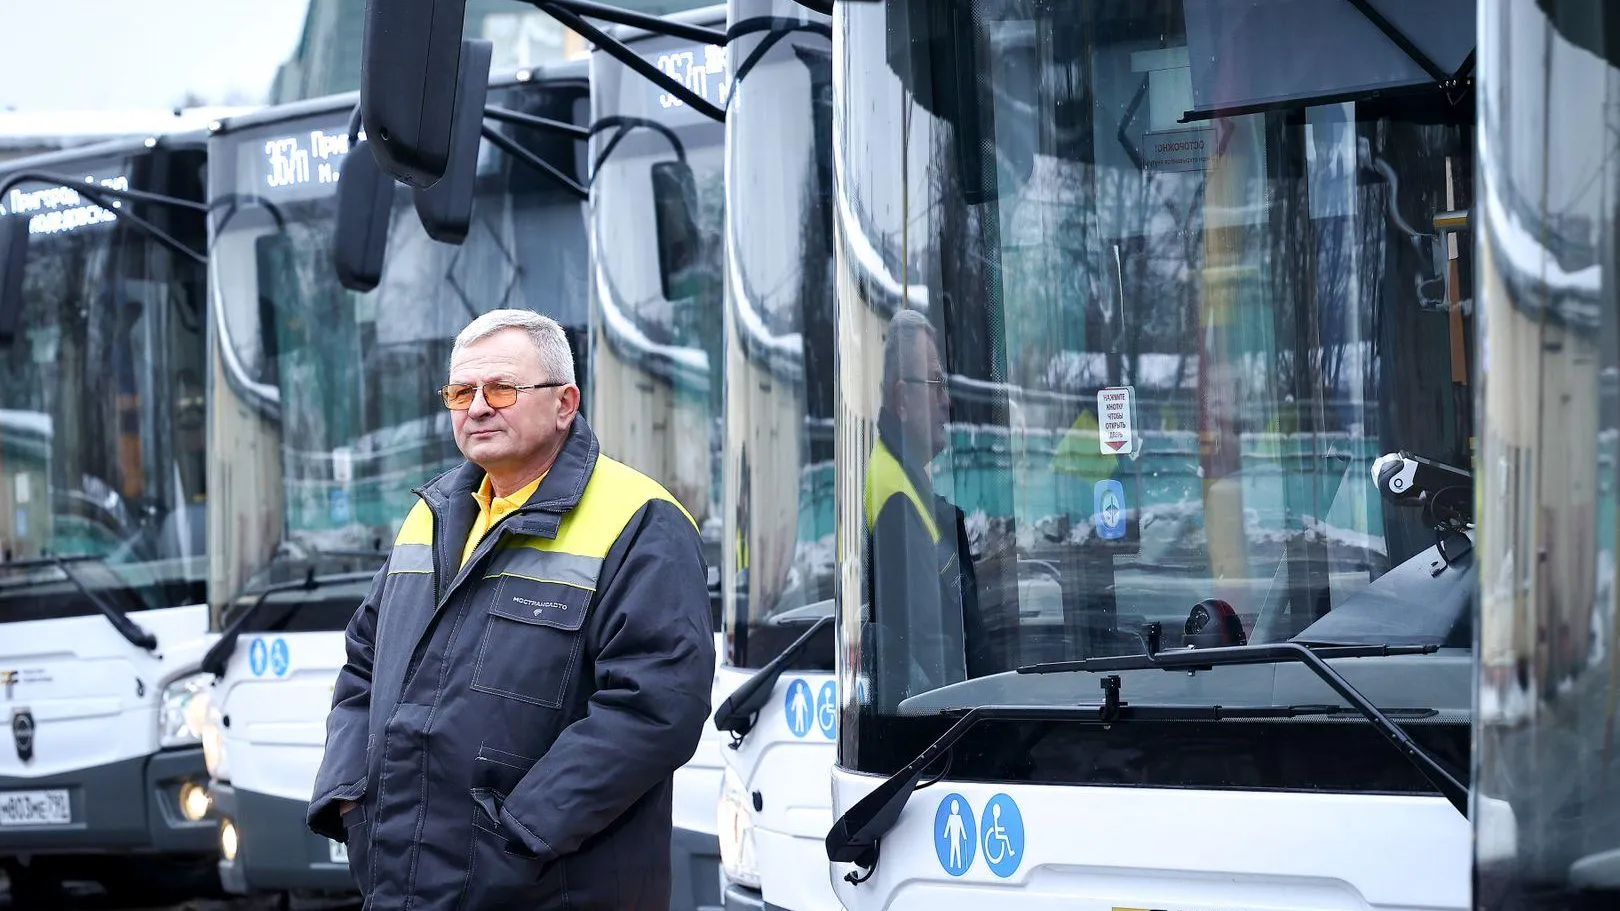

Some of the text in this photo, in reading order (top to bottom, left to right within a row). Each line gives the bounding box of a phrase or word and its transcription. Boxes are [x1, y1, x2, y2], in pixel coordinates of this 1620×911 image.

[1103, 393, 1125, 401] НАЖМИТЕ
[1109, 431, 1123, 439] ДВЕРЬ
[513, 596, 568, 610] МОСТРАНСАВТО
